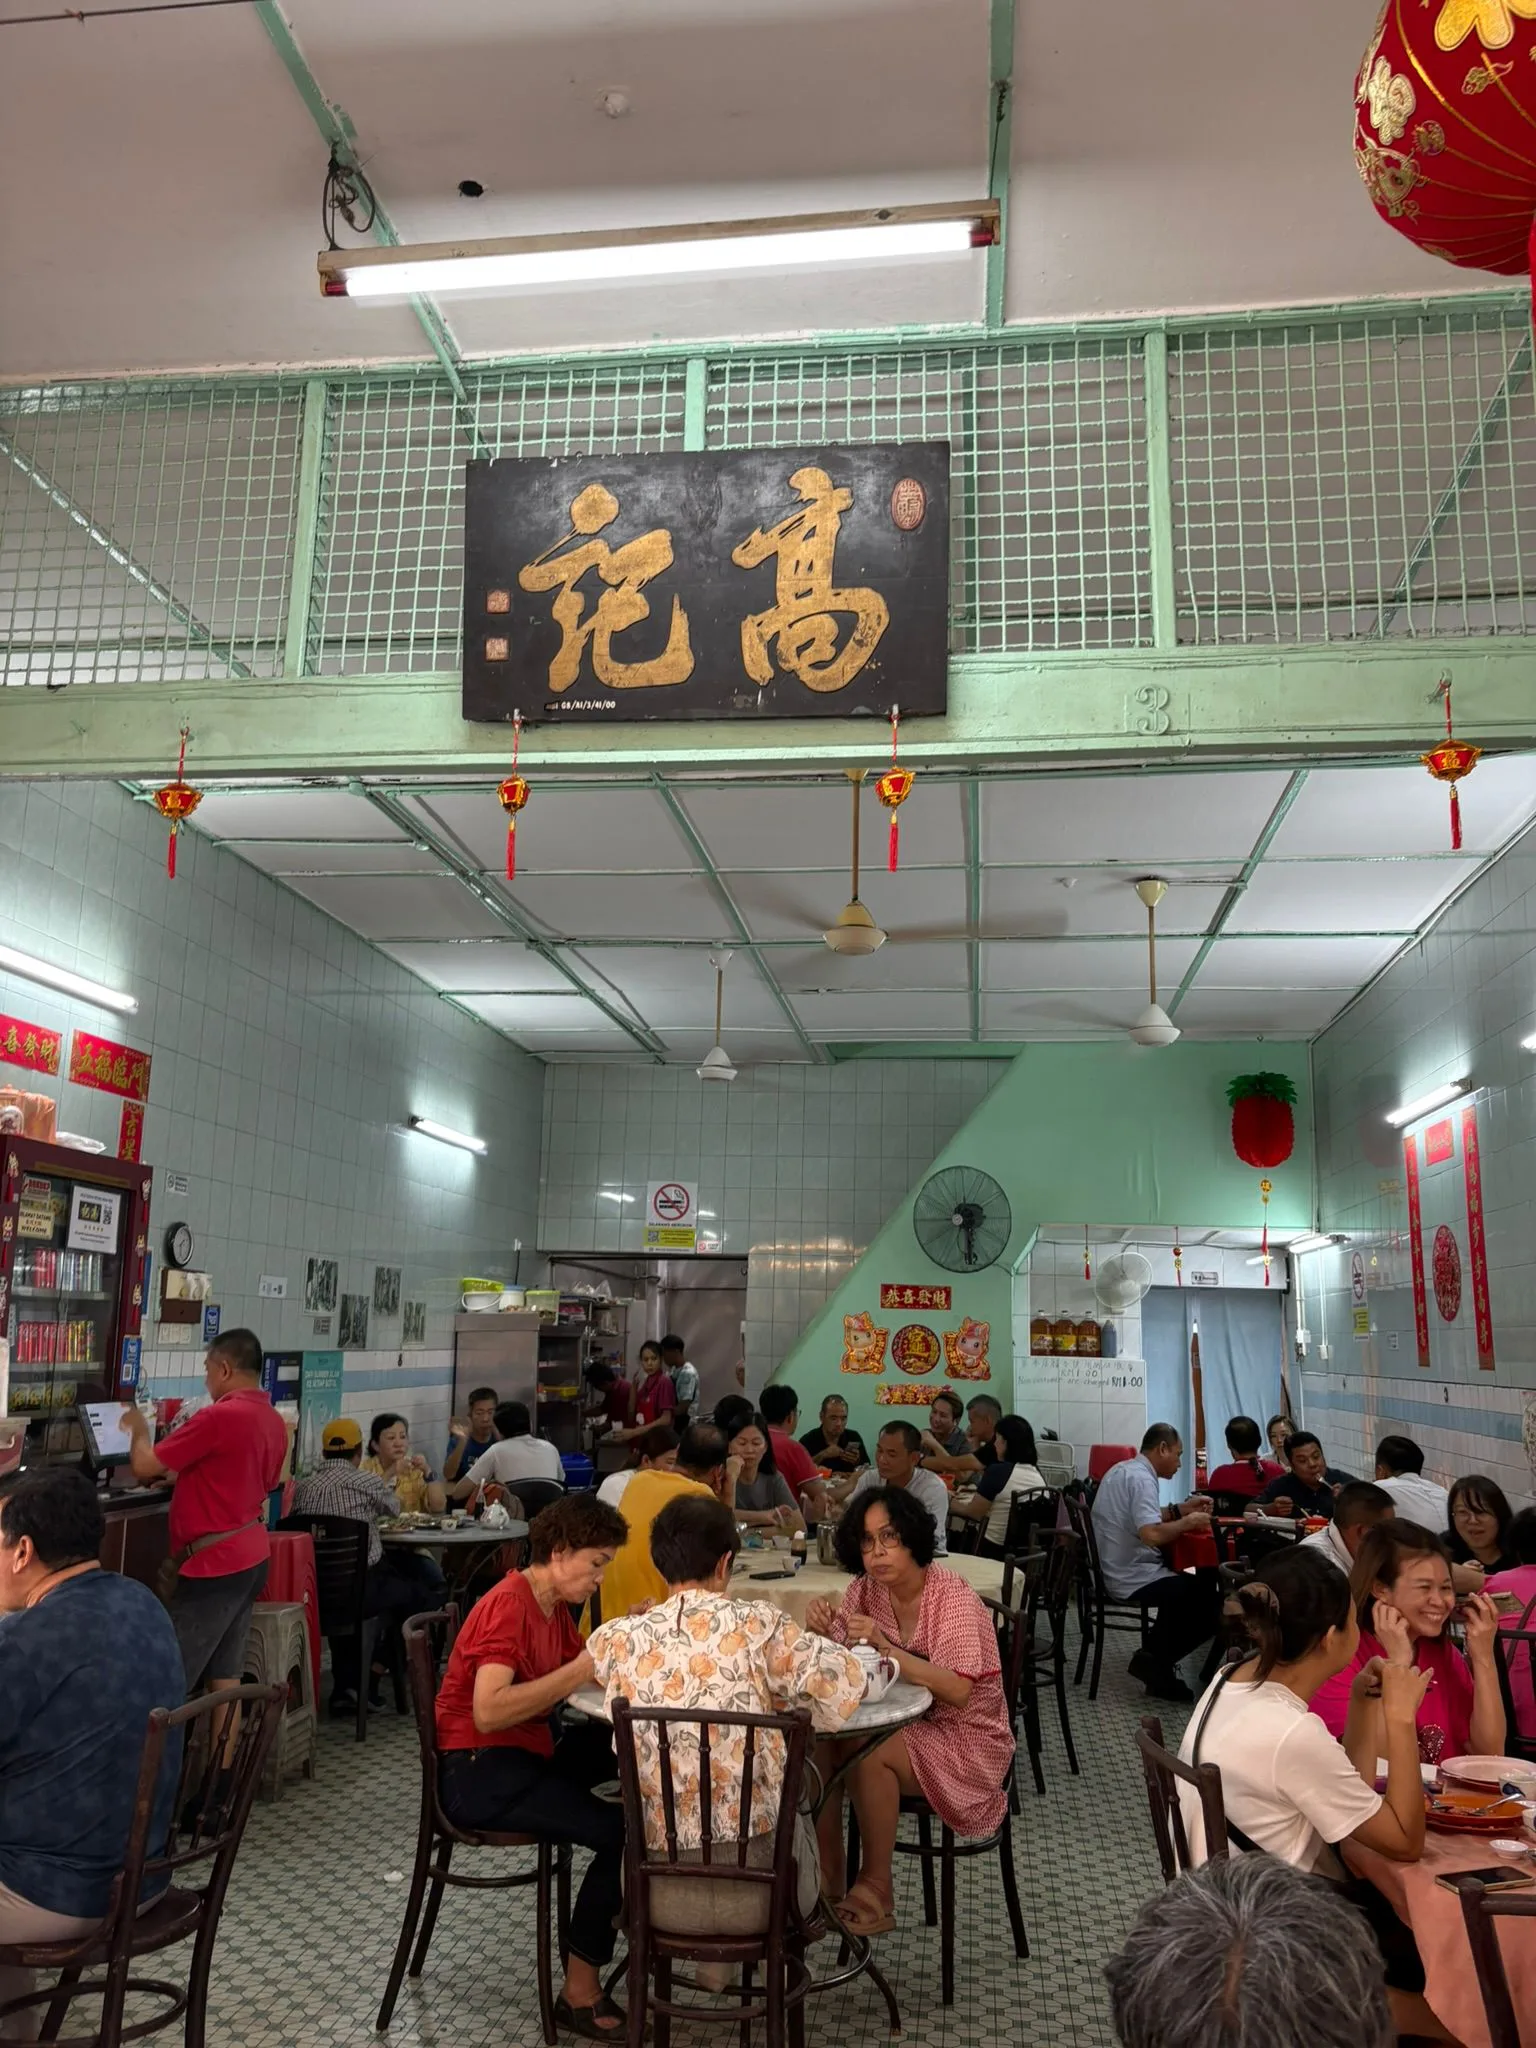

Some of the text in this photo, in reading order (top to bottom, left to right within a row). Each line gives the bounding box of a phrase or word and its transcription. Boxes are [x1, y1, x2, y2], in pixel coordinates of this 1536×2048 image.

[1135, 684, 1170, 736] 3
[886, 1287, 947, 1306] 恭喜發財
